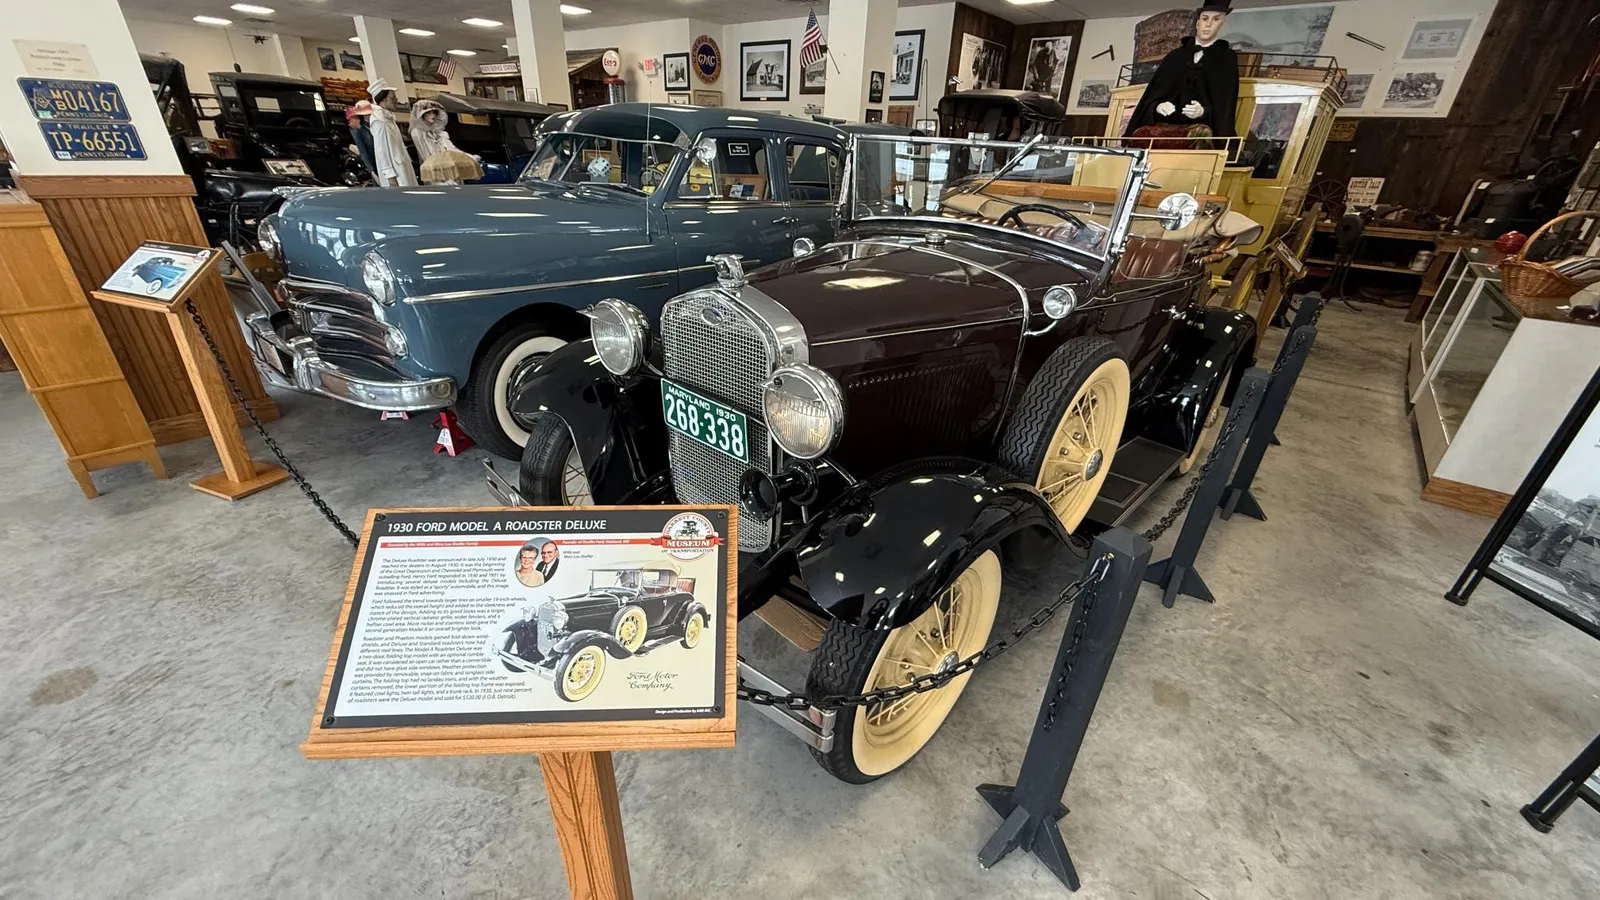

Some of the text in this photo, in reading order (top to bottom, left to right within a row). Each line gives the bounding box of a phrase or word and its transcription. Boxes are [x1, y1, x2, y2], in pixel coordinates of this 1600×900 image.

[604, 58, 617, 66] Esso
[698, 54, 716, 67] GMC
[48, 132, 137, 151] TP-66551
[669, 386, 736, 421] MARYLAND 1930
[387, 520, 607, 533] 1930 FORD MODEL A ROADSTER DELUXE
[666, 516, 710, 534] GARRETT COUNTY
[627, 670, 678, 682] Ford Motor
